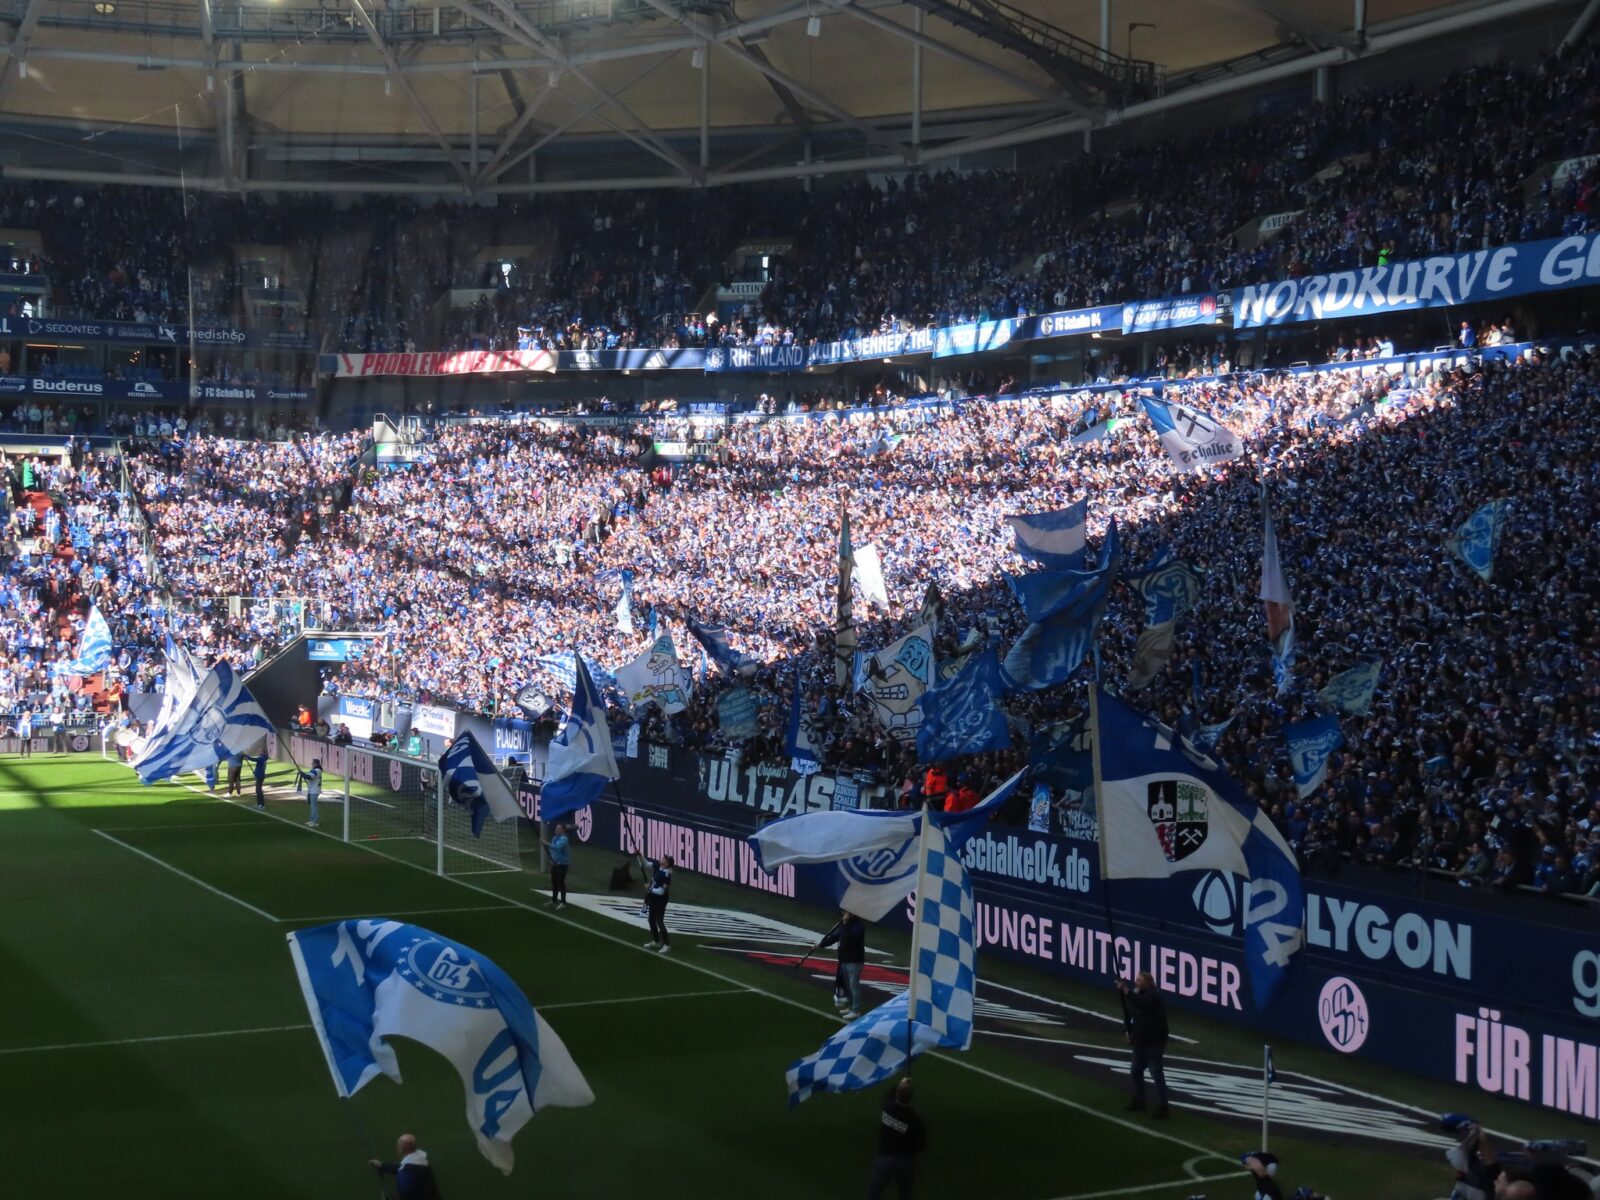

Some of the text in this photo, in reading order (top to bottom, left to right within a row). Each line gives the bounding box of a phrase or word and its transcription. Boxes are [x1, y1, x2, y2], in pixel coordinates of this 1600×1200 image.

[1239, 247, 1518, 323] NORDKURVE
[1135, 305, 1199, 324] HAMBURG
[46, 323, 101, 335] SECONTEC
[729, 347, 803, 367] RHEINLAND
[33, 379, 103, 392] Buderus
[1179, 441, 1234, 464] Schalke
[620, 807, 644, 856] FÜR
[647, 818, 694, 871] IMMER
[698, 830, 735, 882] MEIN
[976, 902, 1053, 960] JUNGE
[1061, 922, 1243, 1011] MITGLIEDER
[1455, 1006, 1530, 1101] FÜR
